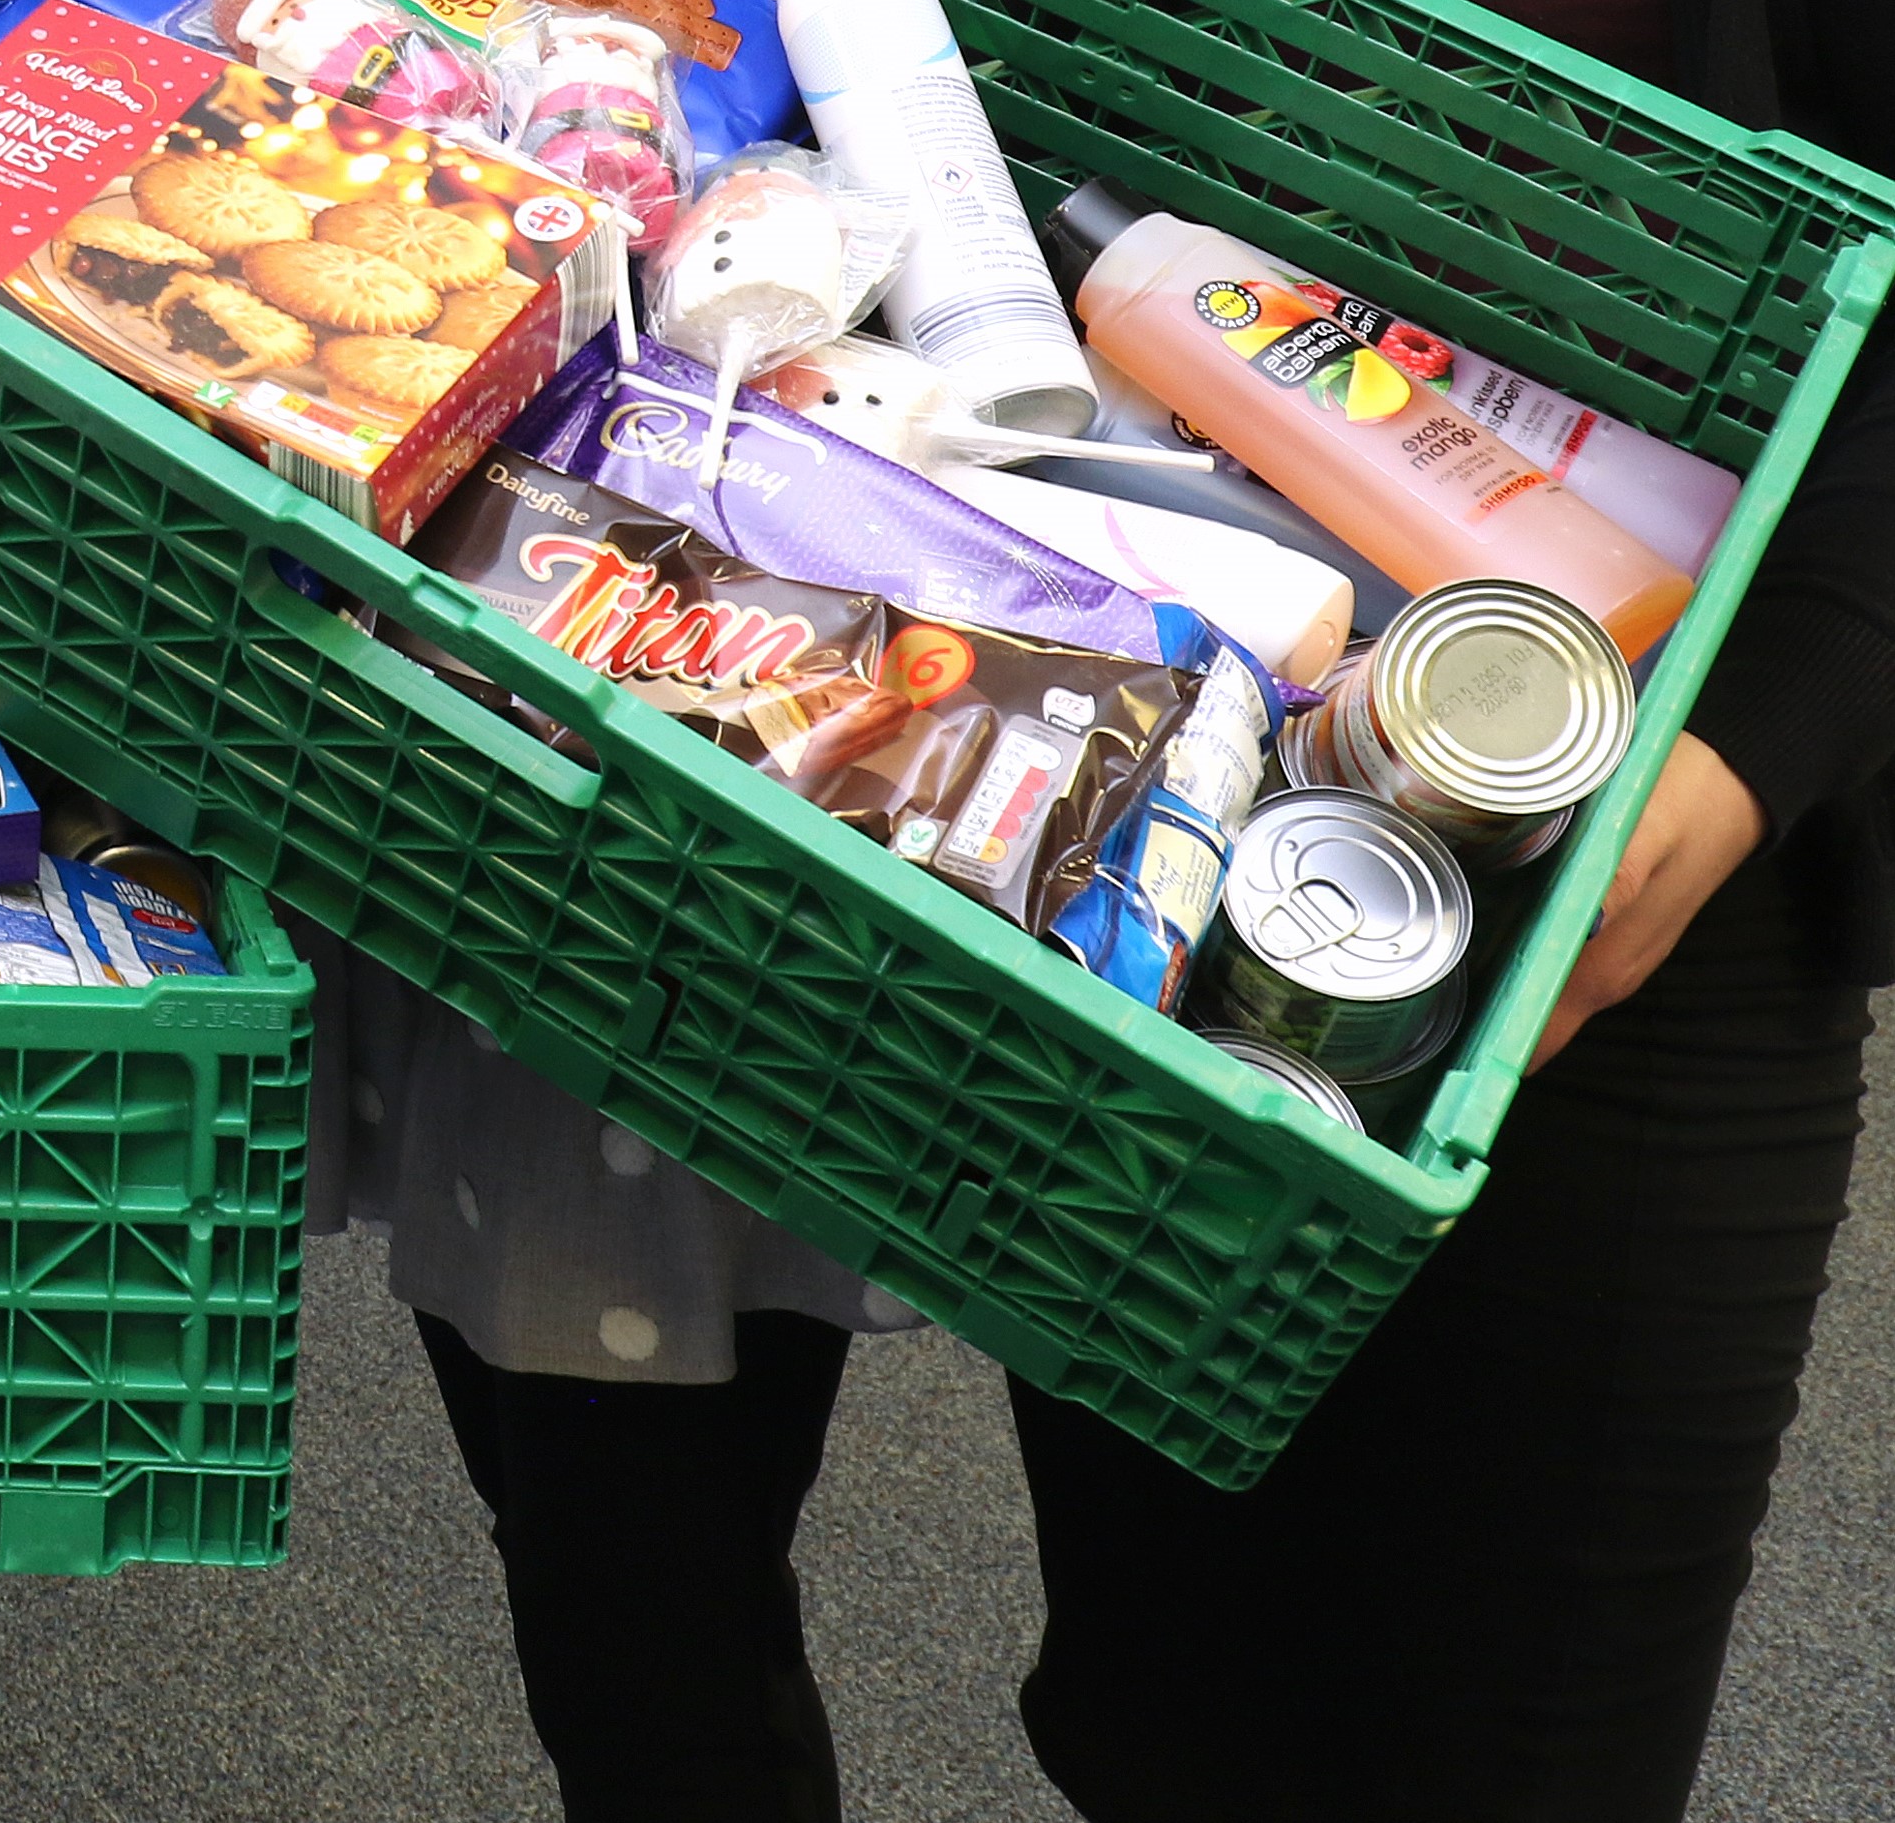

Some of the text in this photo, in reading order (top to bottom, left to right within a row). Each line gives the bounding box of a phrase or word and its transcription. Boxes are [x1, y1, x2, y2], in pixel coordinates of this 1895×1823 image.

[26, 52, 144, 113] Holly Lane
[5, 91, 56, 119] Deep
[56, 111, 117, 141] Filled
[1200, 282, 1235, 297] HOUR
[1215, 295, 1239, 314] NEW
[1263, 321, 1341, 371] alberto
[1273, 333, 1352, 384] balsam
[600, 400, 791, 505] Cadury
[1402, 415, 1458, 453] exotic
[1410, 426, 1478, 471] mango
[486, 462, 591, 526] Dairyfine
[1479, 475, 1536, 512] SHAMPOO
[519, 533, 816, 685] Titan
